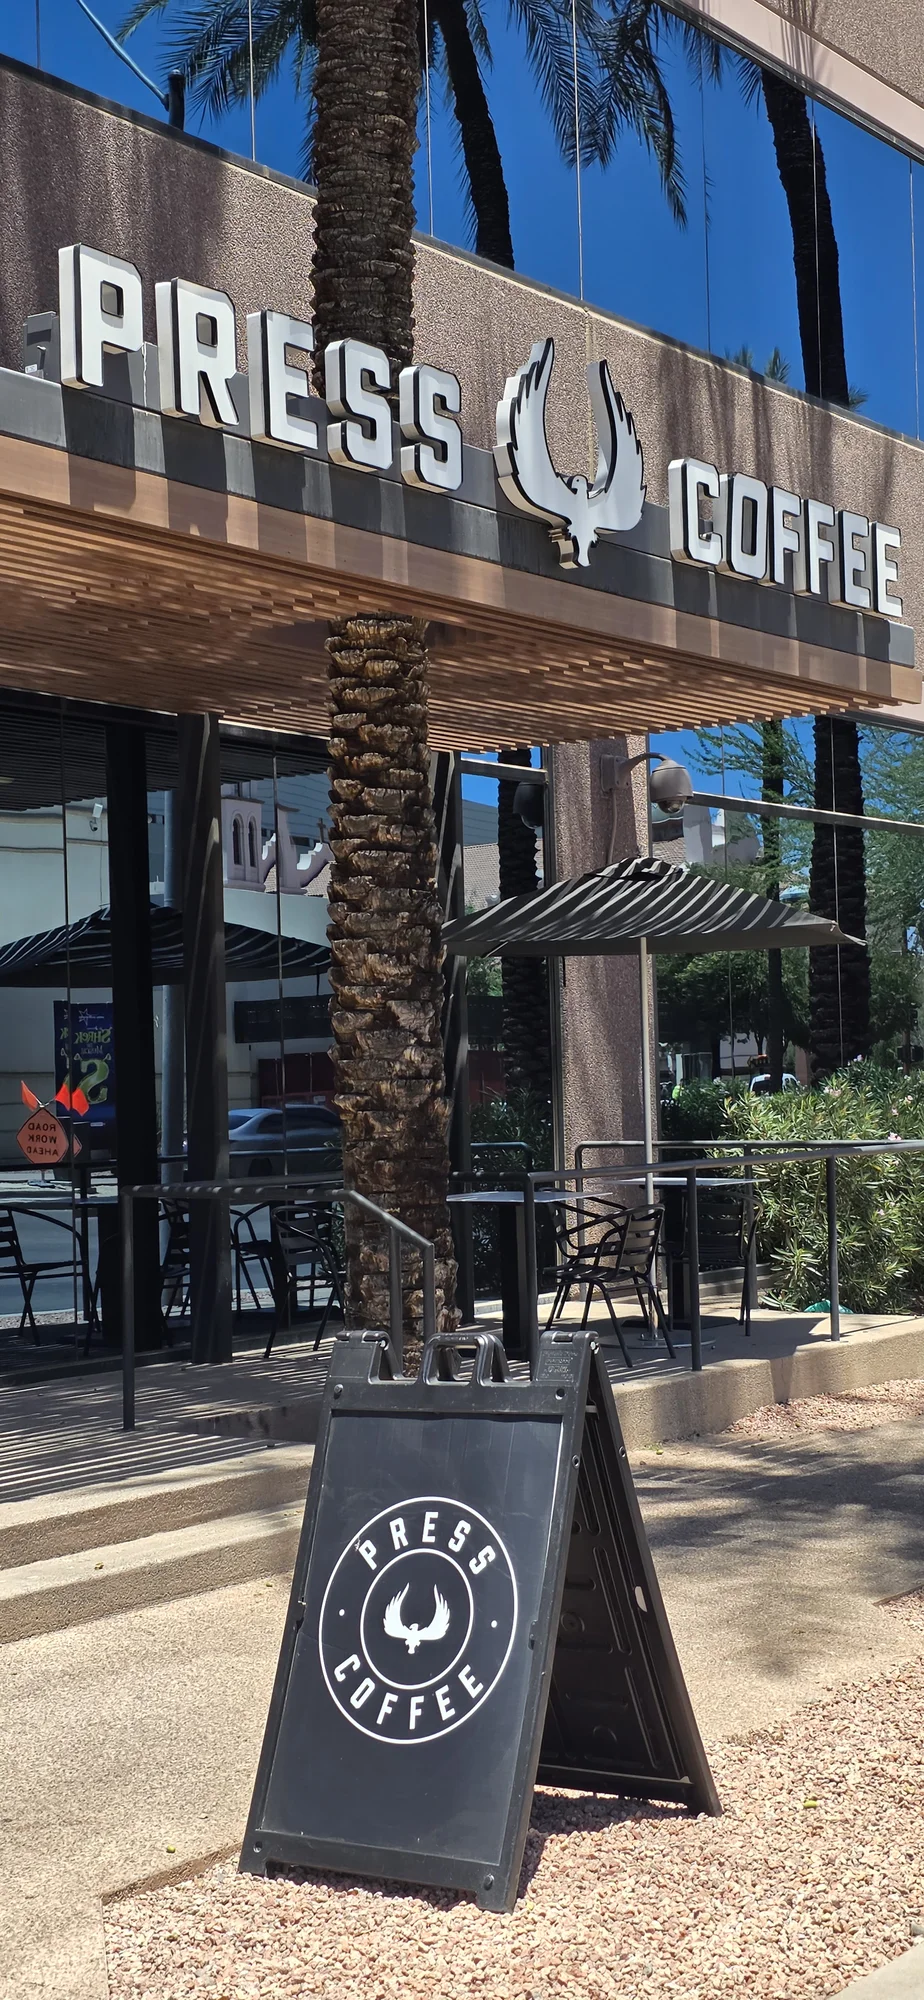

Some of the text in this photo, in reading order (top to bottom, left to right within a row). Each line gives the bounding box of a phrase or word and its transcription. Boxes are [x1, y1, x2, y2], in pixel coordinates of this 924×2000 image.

[58, 243, 903, 618] PRESS COFFEE
[358, 1511, 496, 1575] PRESS
[334, 1654, 484, 1730] COFFEE
